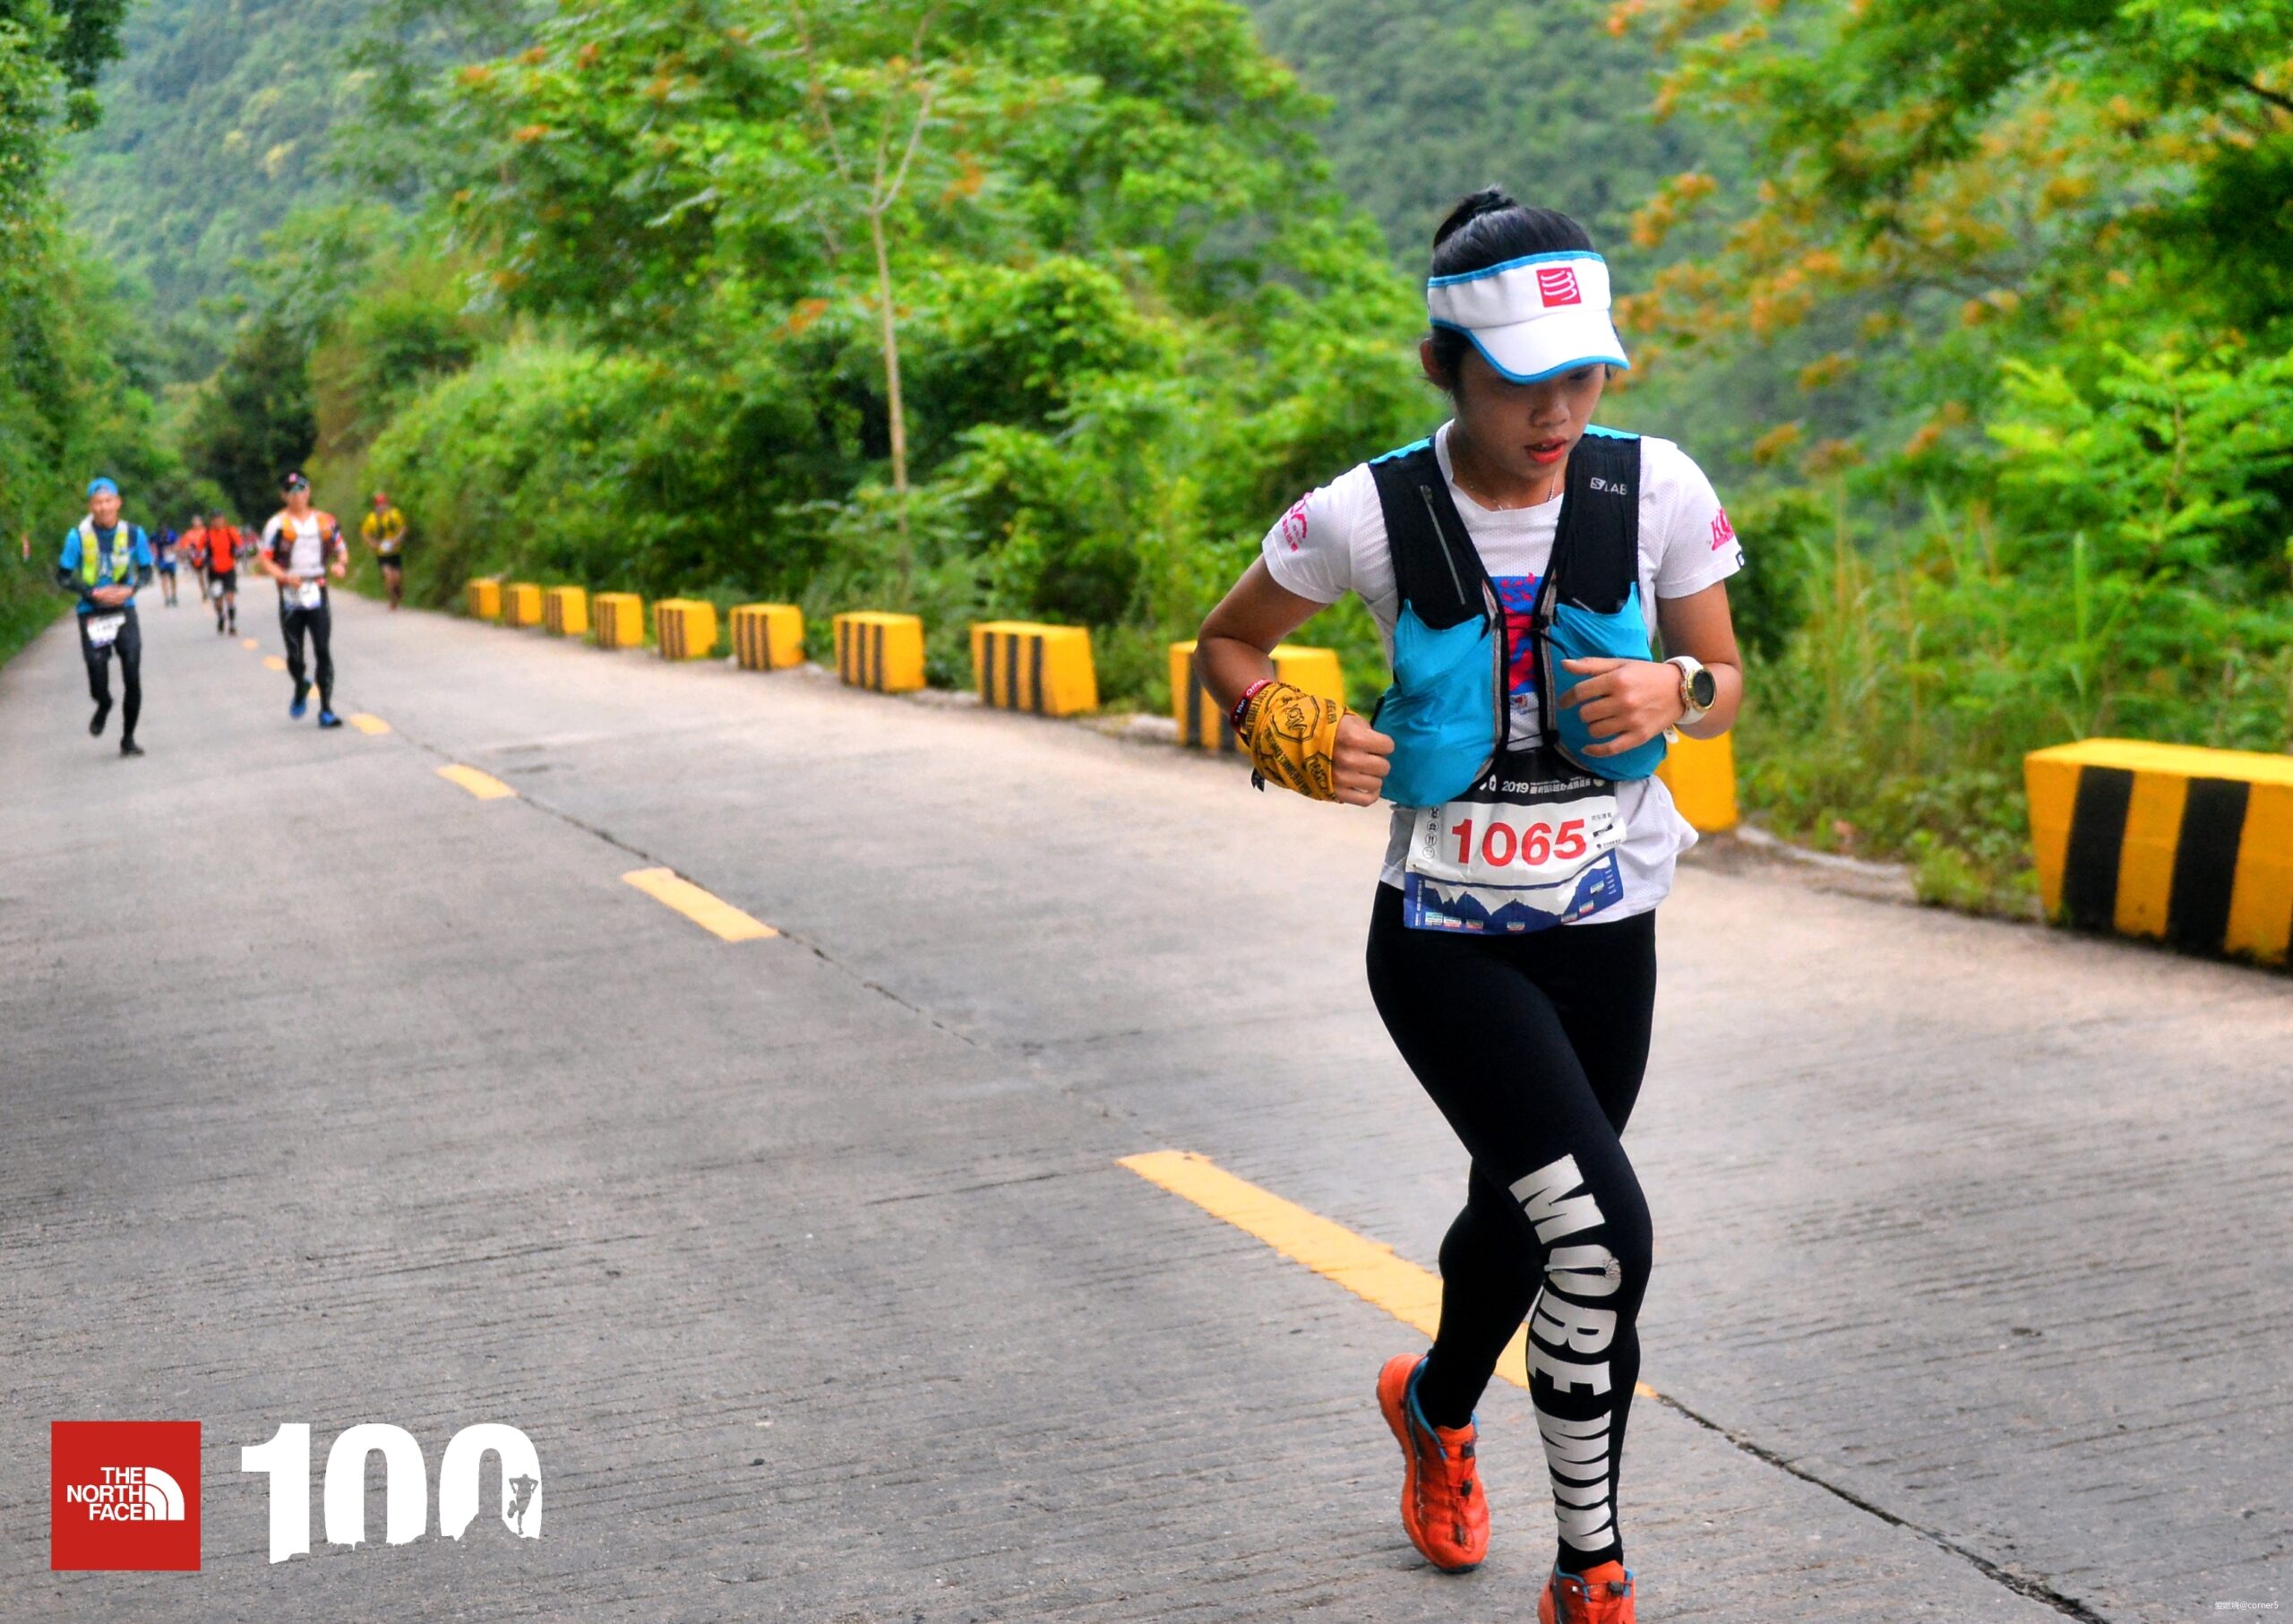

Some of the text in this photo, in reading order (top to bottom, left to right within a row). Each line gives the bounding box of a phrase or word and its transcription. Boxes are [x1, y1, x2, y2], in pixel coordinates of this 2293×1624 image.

[1501, 780, 1529, 794] 2019
[1452, 819, 1587, 867] 1065
[1508, 1153, 1622, 1396] MORE
[1533, 1409, 1615, 1552] WIN
